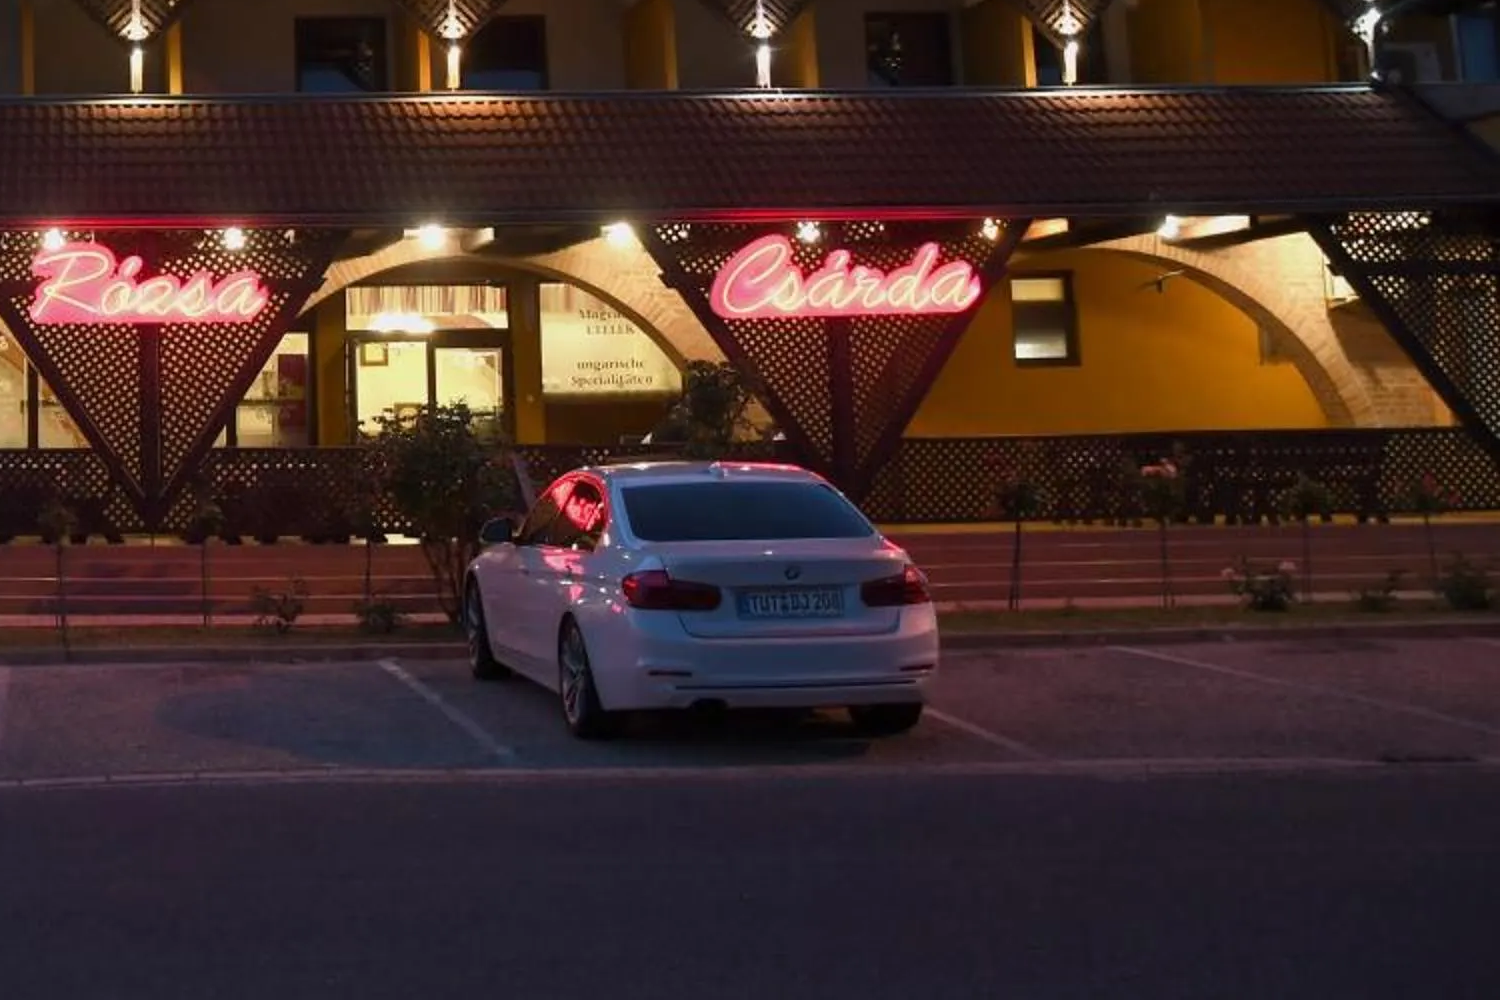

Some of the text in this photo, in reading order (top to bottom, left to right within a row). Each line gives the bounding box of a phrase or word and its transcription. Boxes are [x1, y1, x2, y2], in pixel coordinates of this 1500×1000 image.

[29, 241, 269, 324] Rózsa
[709, 233, 981, 318] Csárda
[577, 358, 644, 371] ungarische
